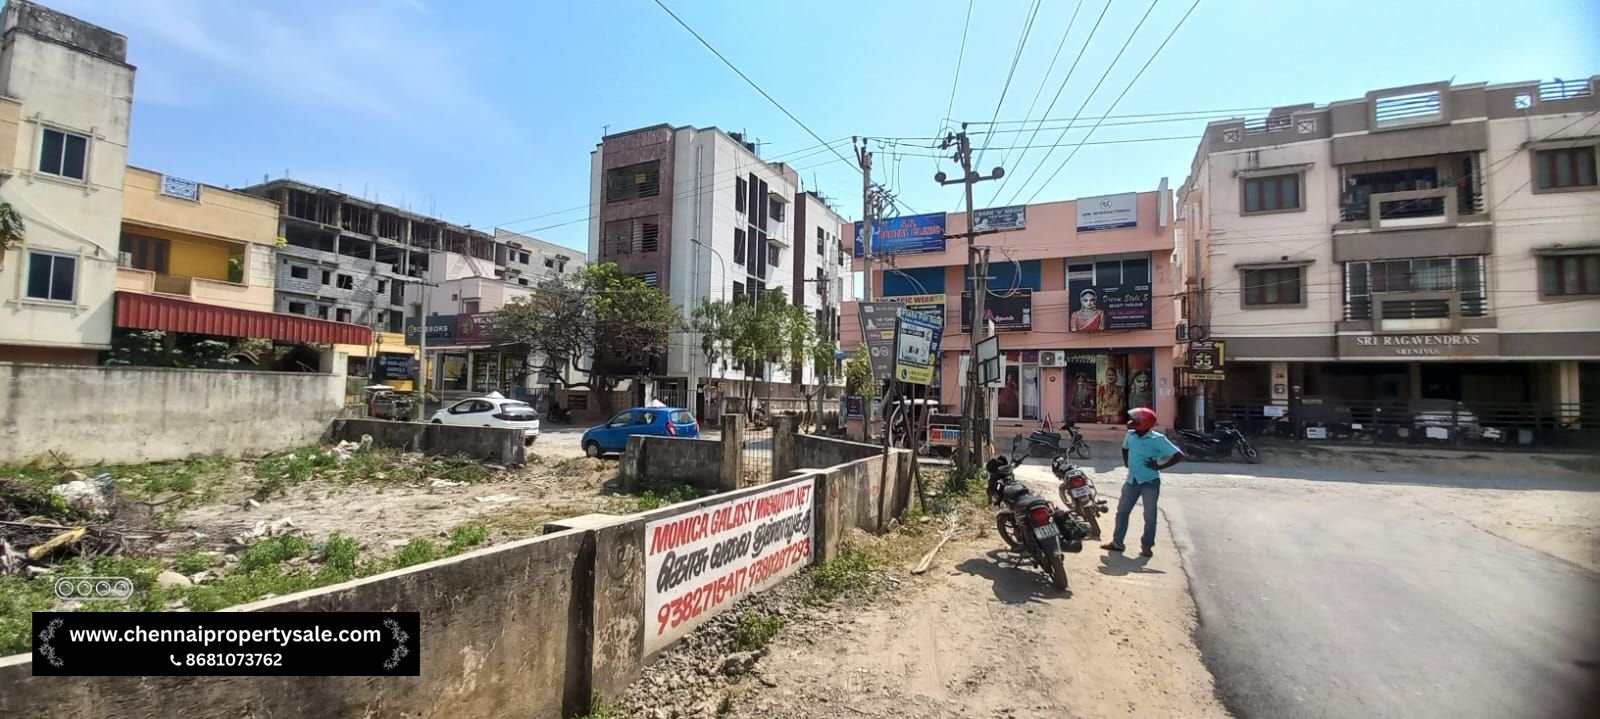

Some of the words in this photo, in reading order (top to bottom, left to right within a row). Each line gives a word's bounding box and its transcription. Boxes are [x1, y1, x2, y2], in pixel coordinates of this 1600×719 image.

[1356, 336, 1378, 346] SRI
[650, 513, 710, 556] MONICA
[711, 500, 756, 535] GALAXY
[795, 485, 812, 508] NET
[710, 530, 752, 570] வலை
